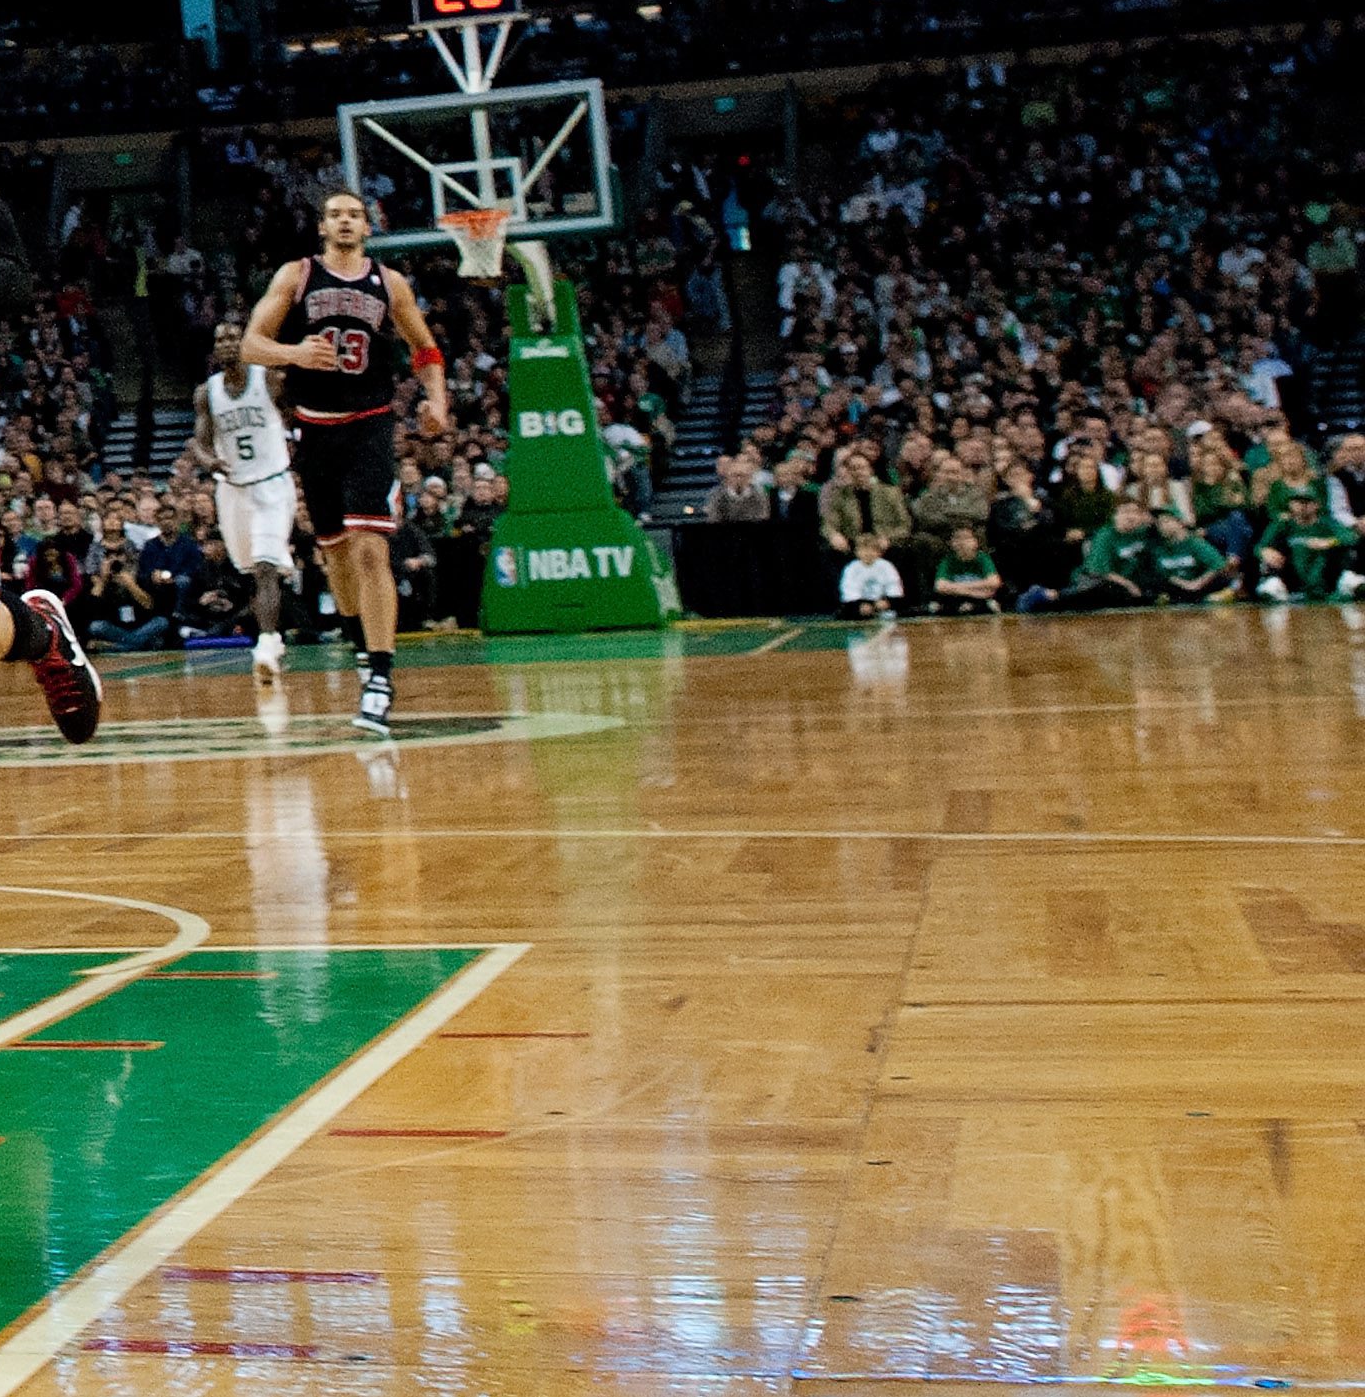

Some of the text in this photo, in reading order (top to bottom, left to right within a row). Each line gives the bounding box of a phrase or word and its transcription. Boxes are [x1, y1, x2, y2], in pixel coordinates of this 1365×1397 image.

[317, 326, 371, 375] 13
[236, 434, 256, 461] 5
[527, 545, 635, 581] NBA TV
